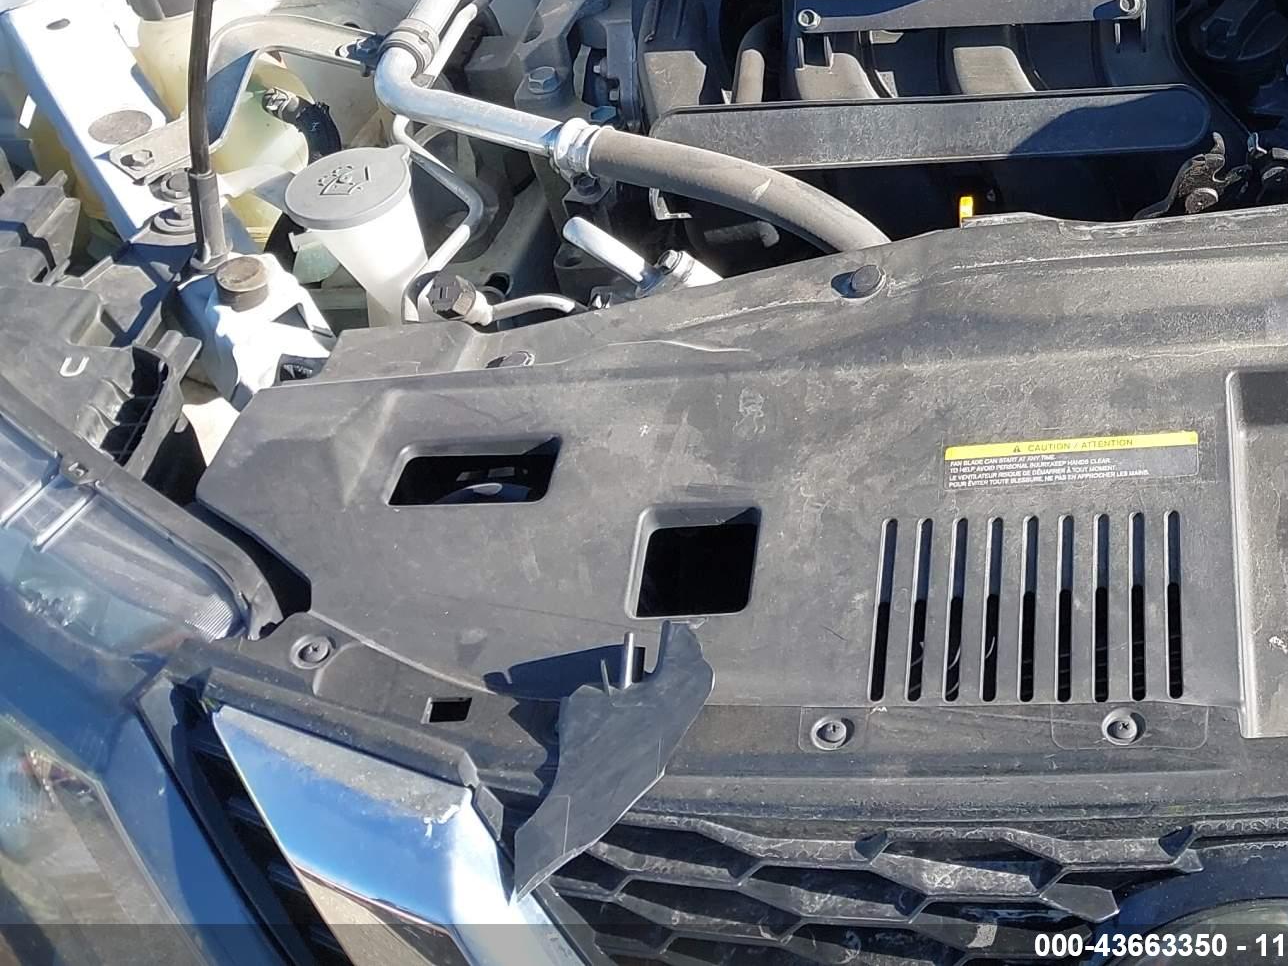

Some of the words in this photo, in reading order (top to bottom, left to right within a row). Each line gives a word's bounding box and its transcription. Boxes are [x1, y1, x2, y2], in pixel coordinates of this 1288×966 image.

[1028, 442, 1070, 452] CAUTION
[1081, 439, 1133, 449] ATTENTION
[958, 472, 997, 480] VENTILATEUR
[968, 478, 988, 487] ÉVITER
